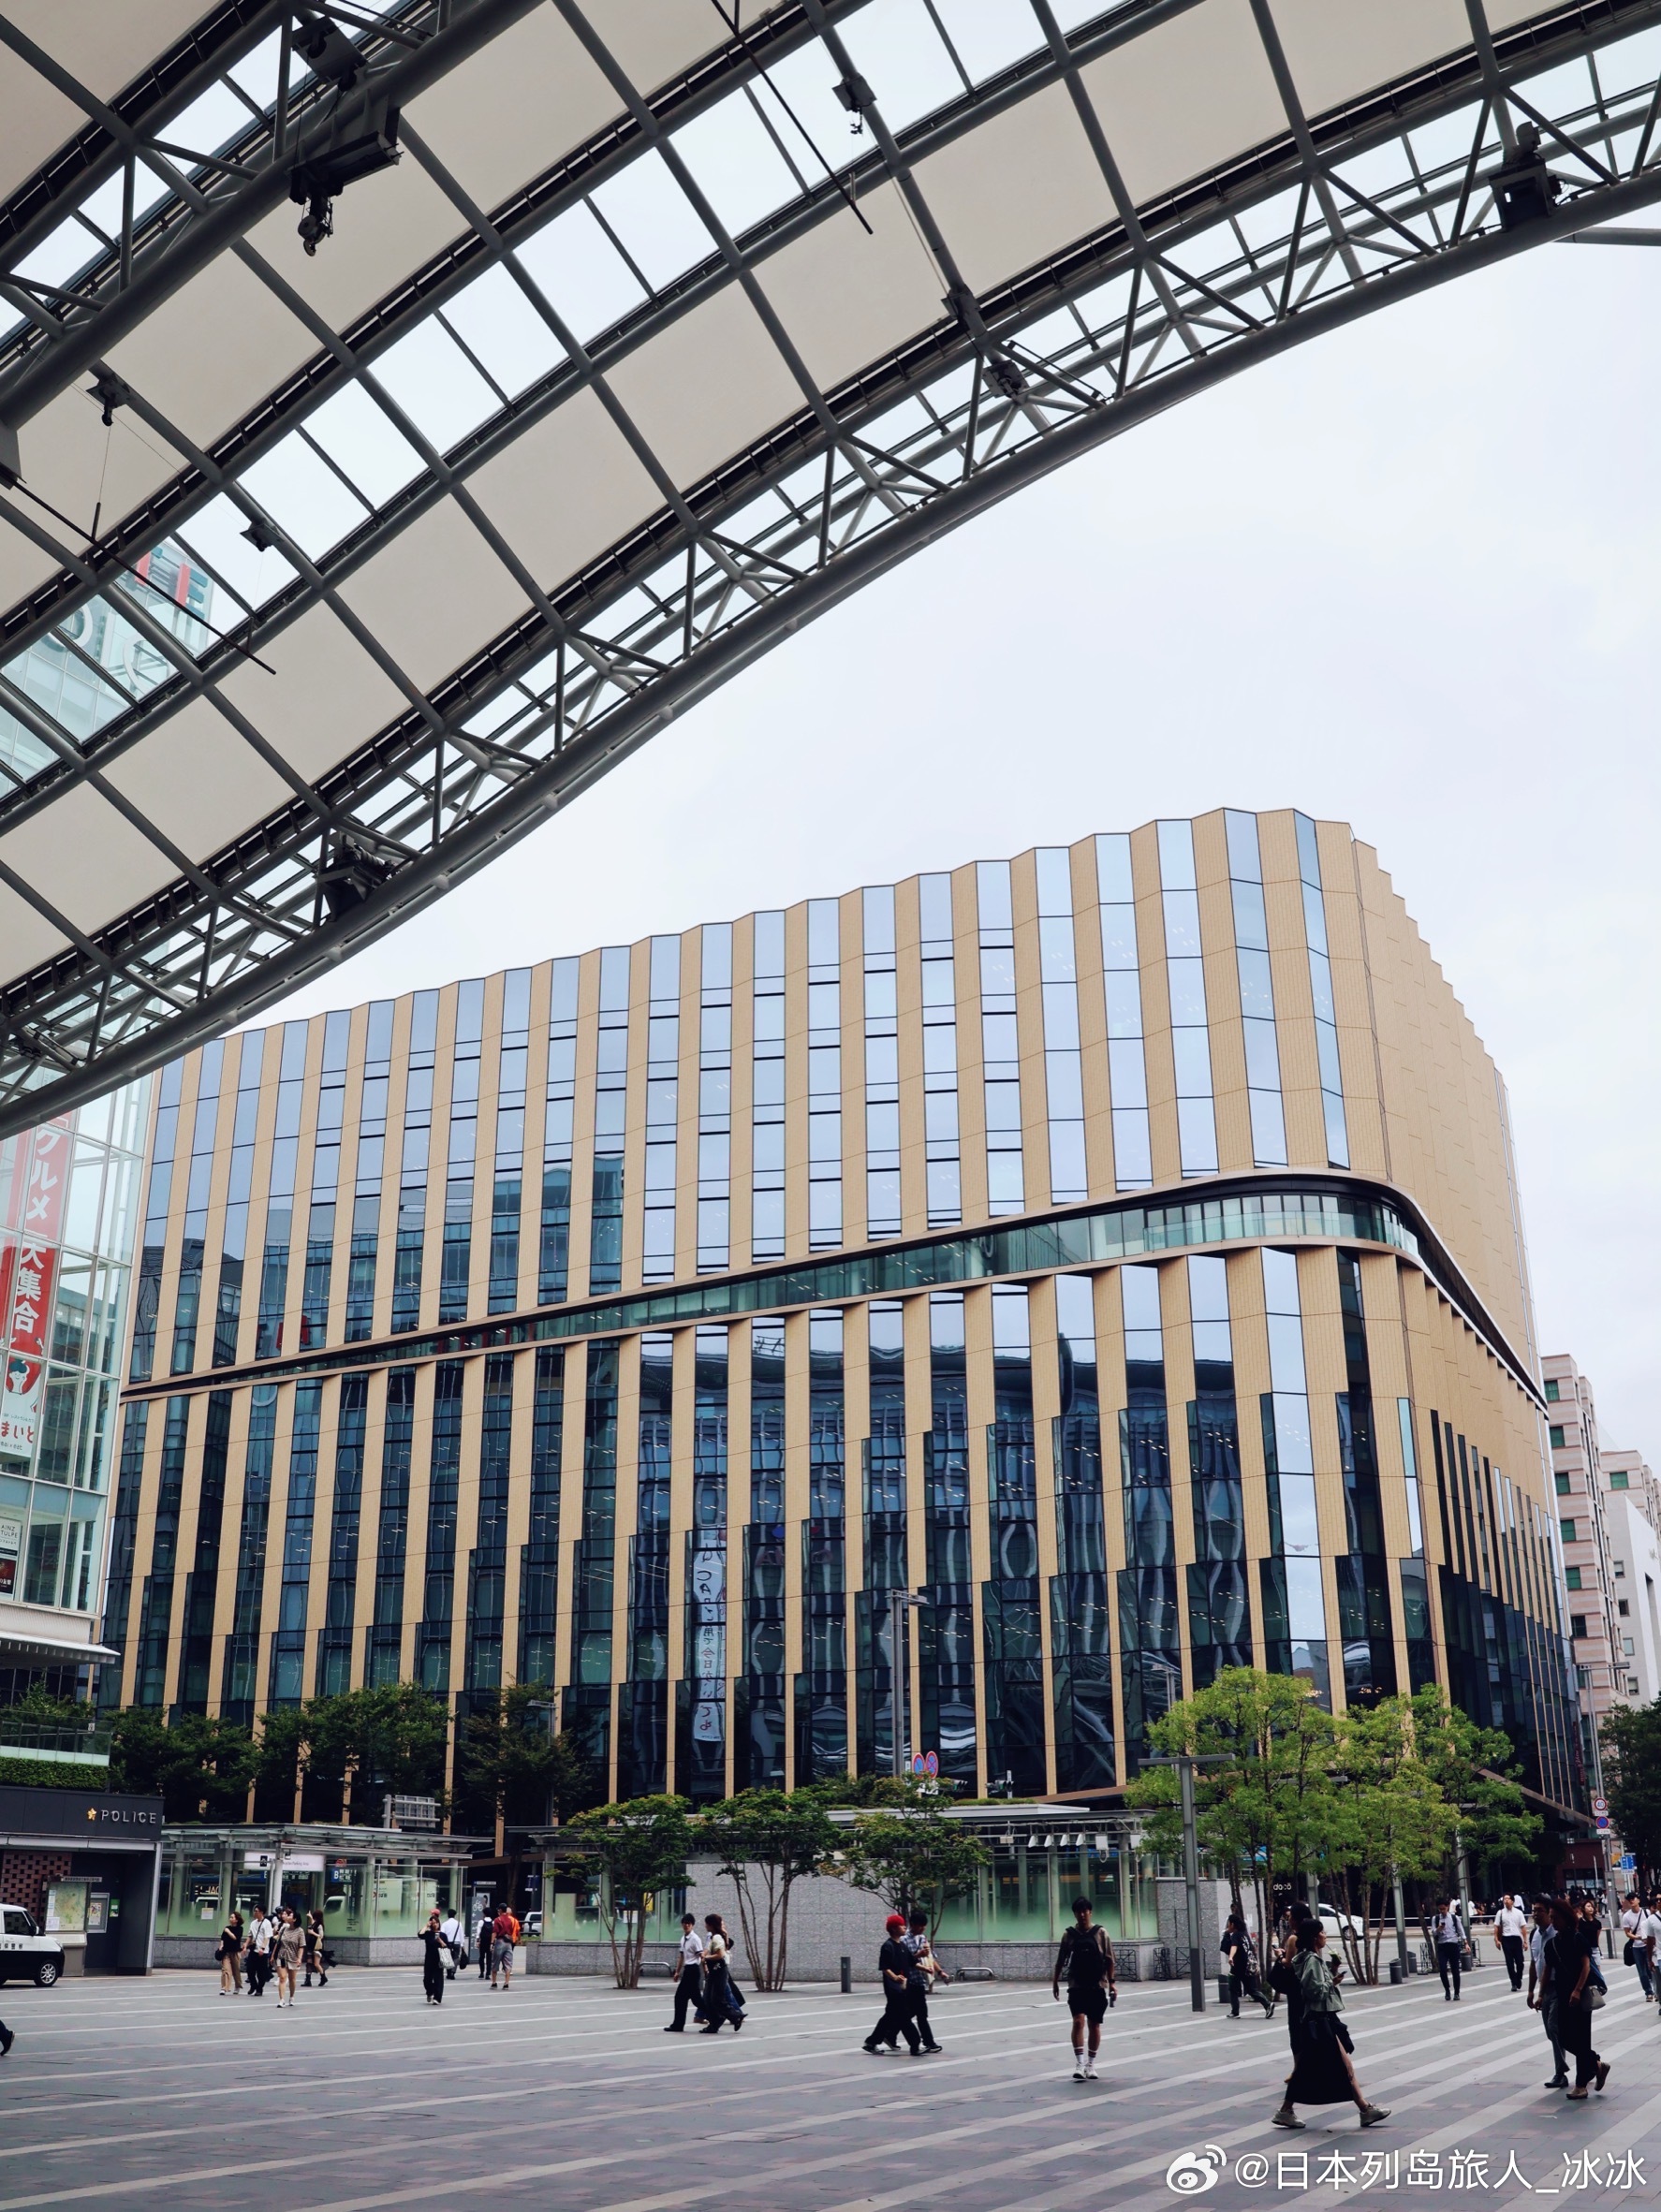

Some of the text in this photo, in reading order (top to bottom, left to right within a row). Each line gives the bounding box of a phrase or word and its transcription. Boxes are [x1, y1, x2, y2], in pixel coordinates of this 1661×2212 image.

[1, 1524, 16, 1532] AINZ
[0, 1530, 18, 1538] TULPE
[101, 1809, 156, 1824] POLICE
